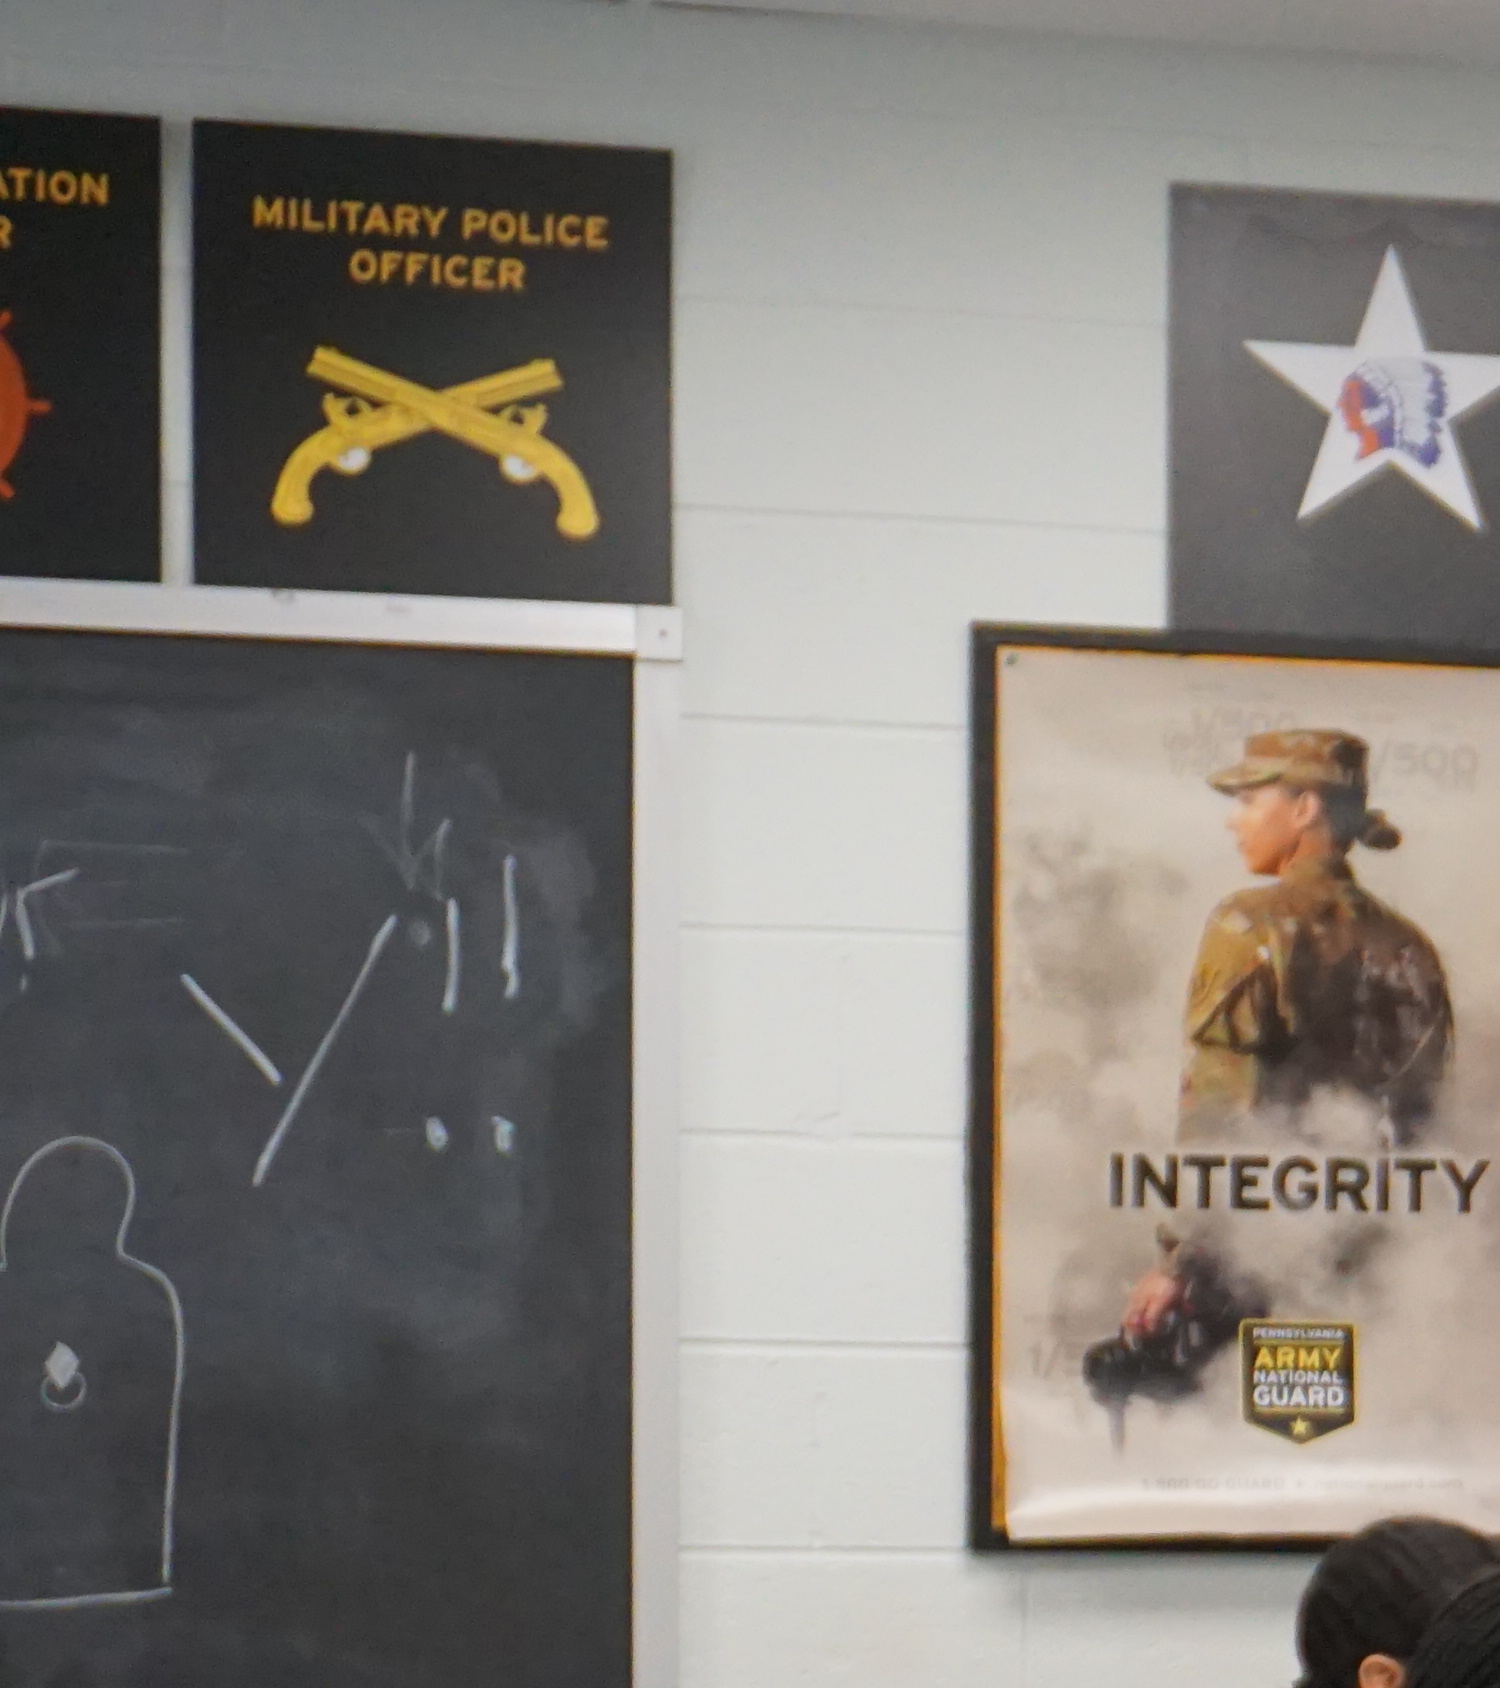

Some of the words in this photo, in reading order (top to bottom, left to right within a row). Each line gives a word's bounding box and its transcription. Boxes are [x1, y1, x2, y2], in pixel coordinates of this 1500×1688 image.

[253, 194, 448, 239] MILITARY
[461, 208, 610, 250] POLICE
[350, 248, 526, 292] OFFICER
[1109, 1152, 1491, 1214] INTEGRITY
[1253, 1346, 1341, 1370] ARMY
[1253, 1369, 1344, 1385] NATIONAL
[1253, 1385, 1345, 1407] GUARD
